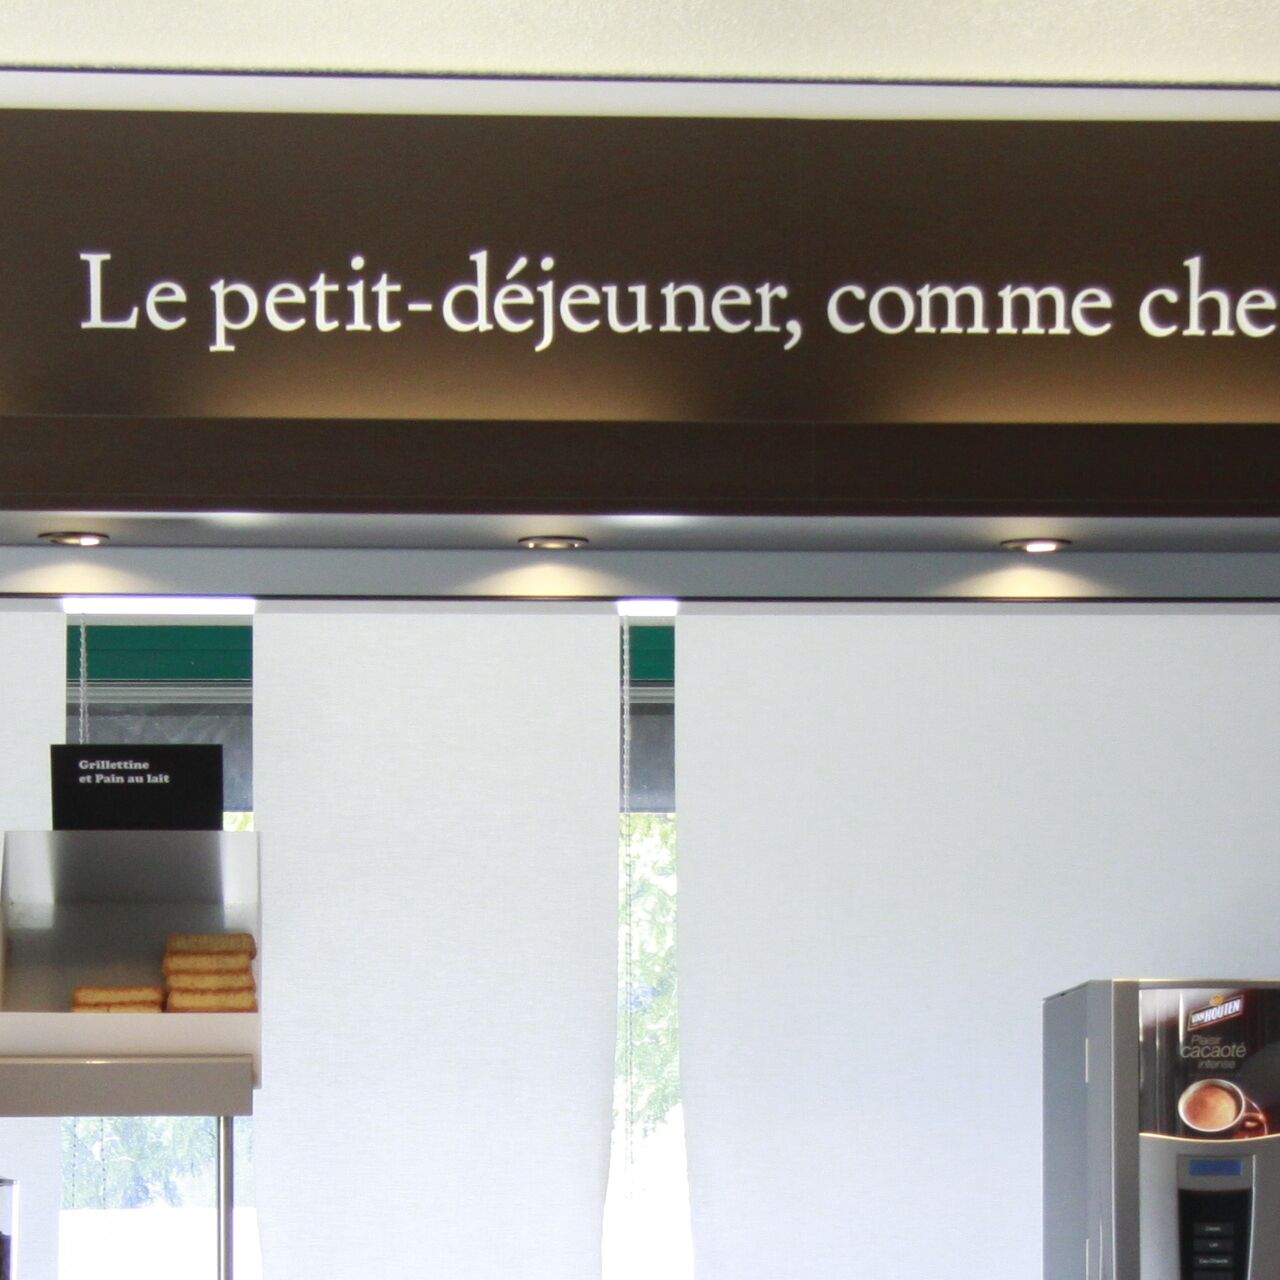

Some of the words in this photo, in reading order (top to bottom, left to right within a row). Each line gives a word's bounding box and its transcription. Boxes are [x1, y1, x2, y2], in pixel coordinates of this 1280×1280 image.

[79, 251, 188, 331] Le
[208, 249, 802, 353] petit-déjeuner,
[827, 284, 1113, 337] comme
[78, 759, 150, 770] Grillettine
[78, 774, 93, 784] et
[94, 773, 125, 784] Pain
[126, 775, 145, 784] au
[146, 773, 170, 784] lait
[1203, 999, 1241, 1023] HOUTEN
[1181, 1041, 1247, 1059] cacaoté
